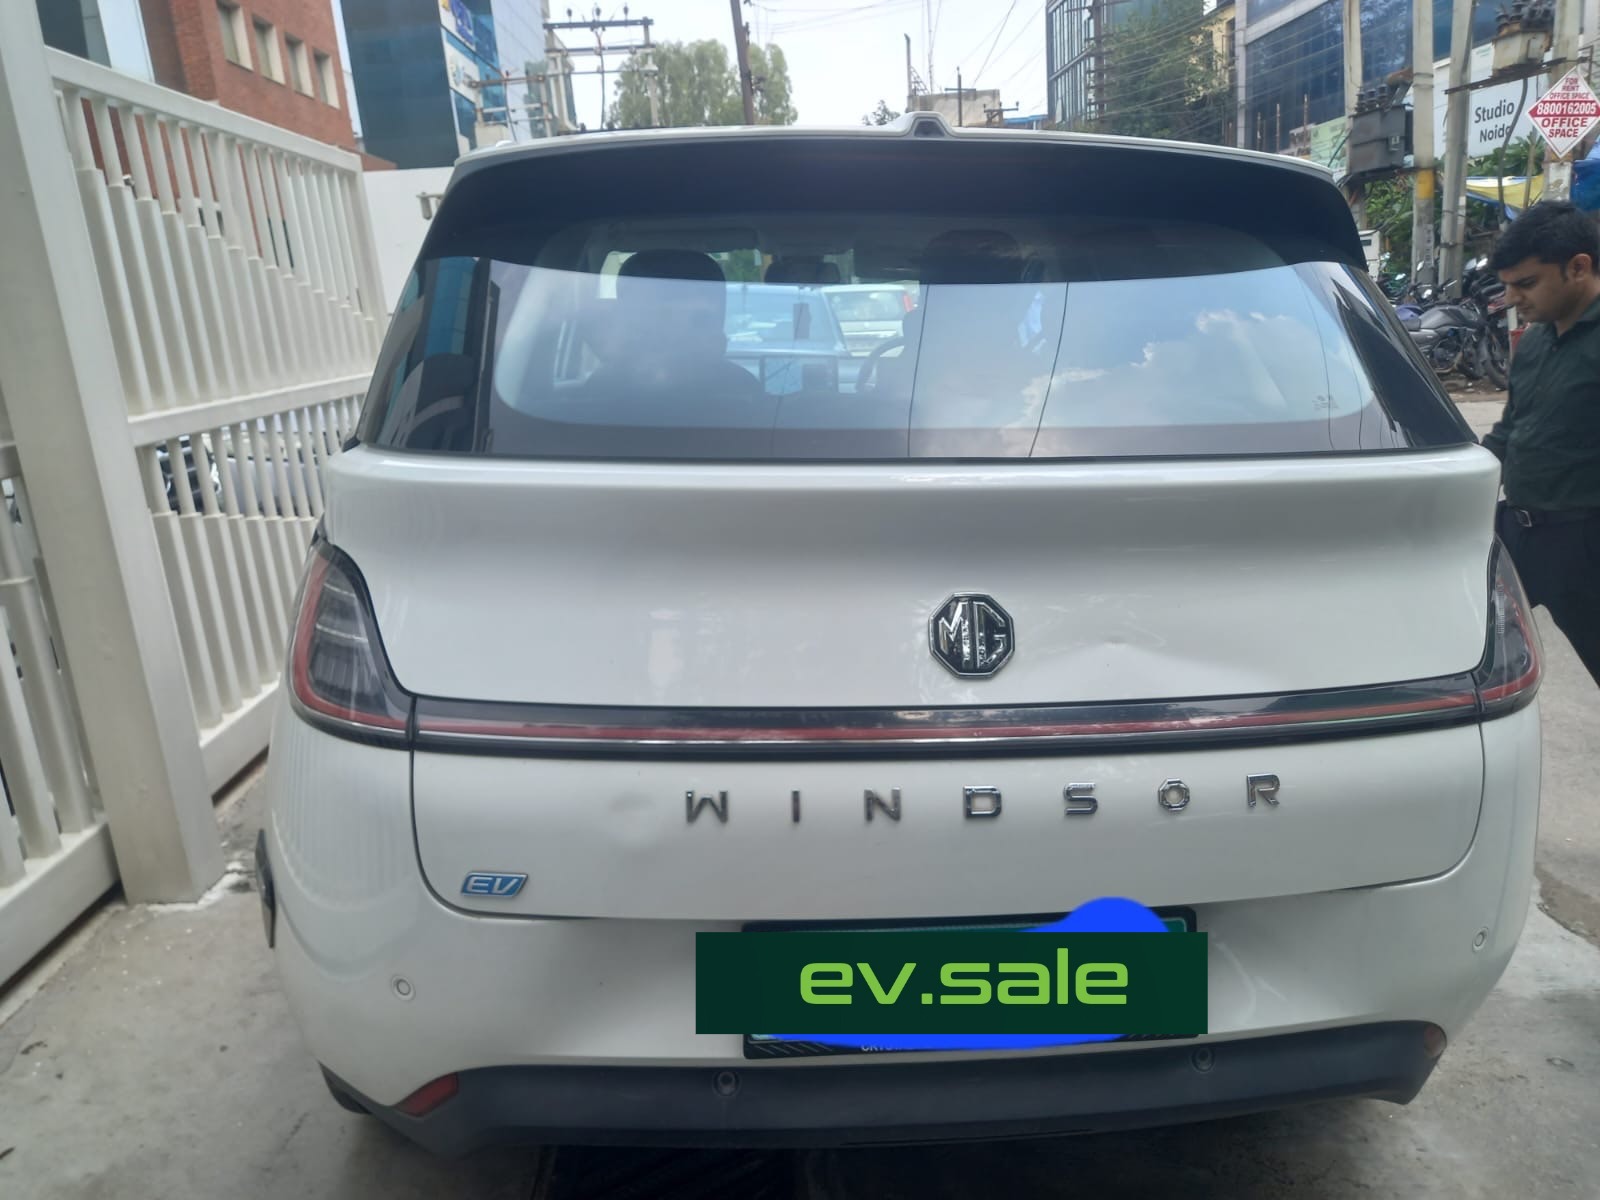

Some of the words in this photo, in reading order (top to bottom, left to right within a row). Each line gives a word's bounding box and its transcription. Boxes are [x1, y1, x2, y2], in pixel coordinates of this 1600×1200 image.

[1565, 77, 1579, 85] FOR
[1549, 92, 1571, 100] OFFICE
[1572, 92, 1590, 100] SPACE
[1474, 99, 1515, 124] Studio
[1536, 102, 1597, 115] 8800162005
[1541, 117, 1588, 128] OFFICE
[1548, 128, 1579, 138] SPACE
[937, 600, 1007, 669] MG
[685, 773, 1281, 824] WINDSOR
[466, 876, 519, 894] EV
